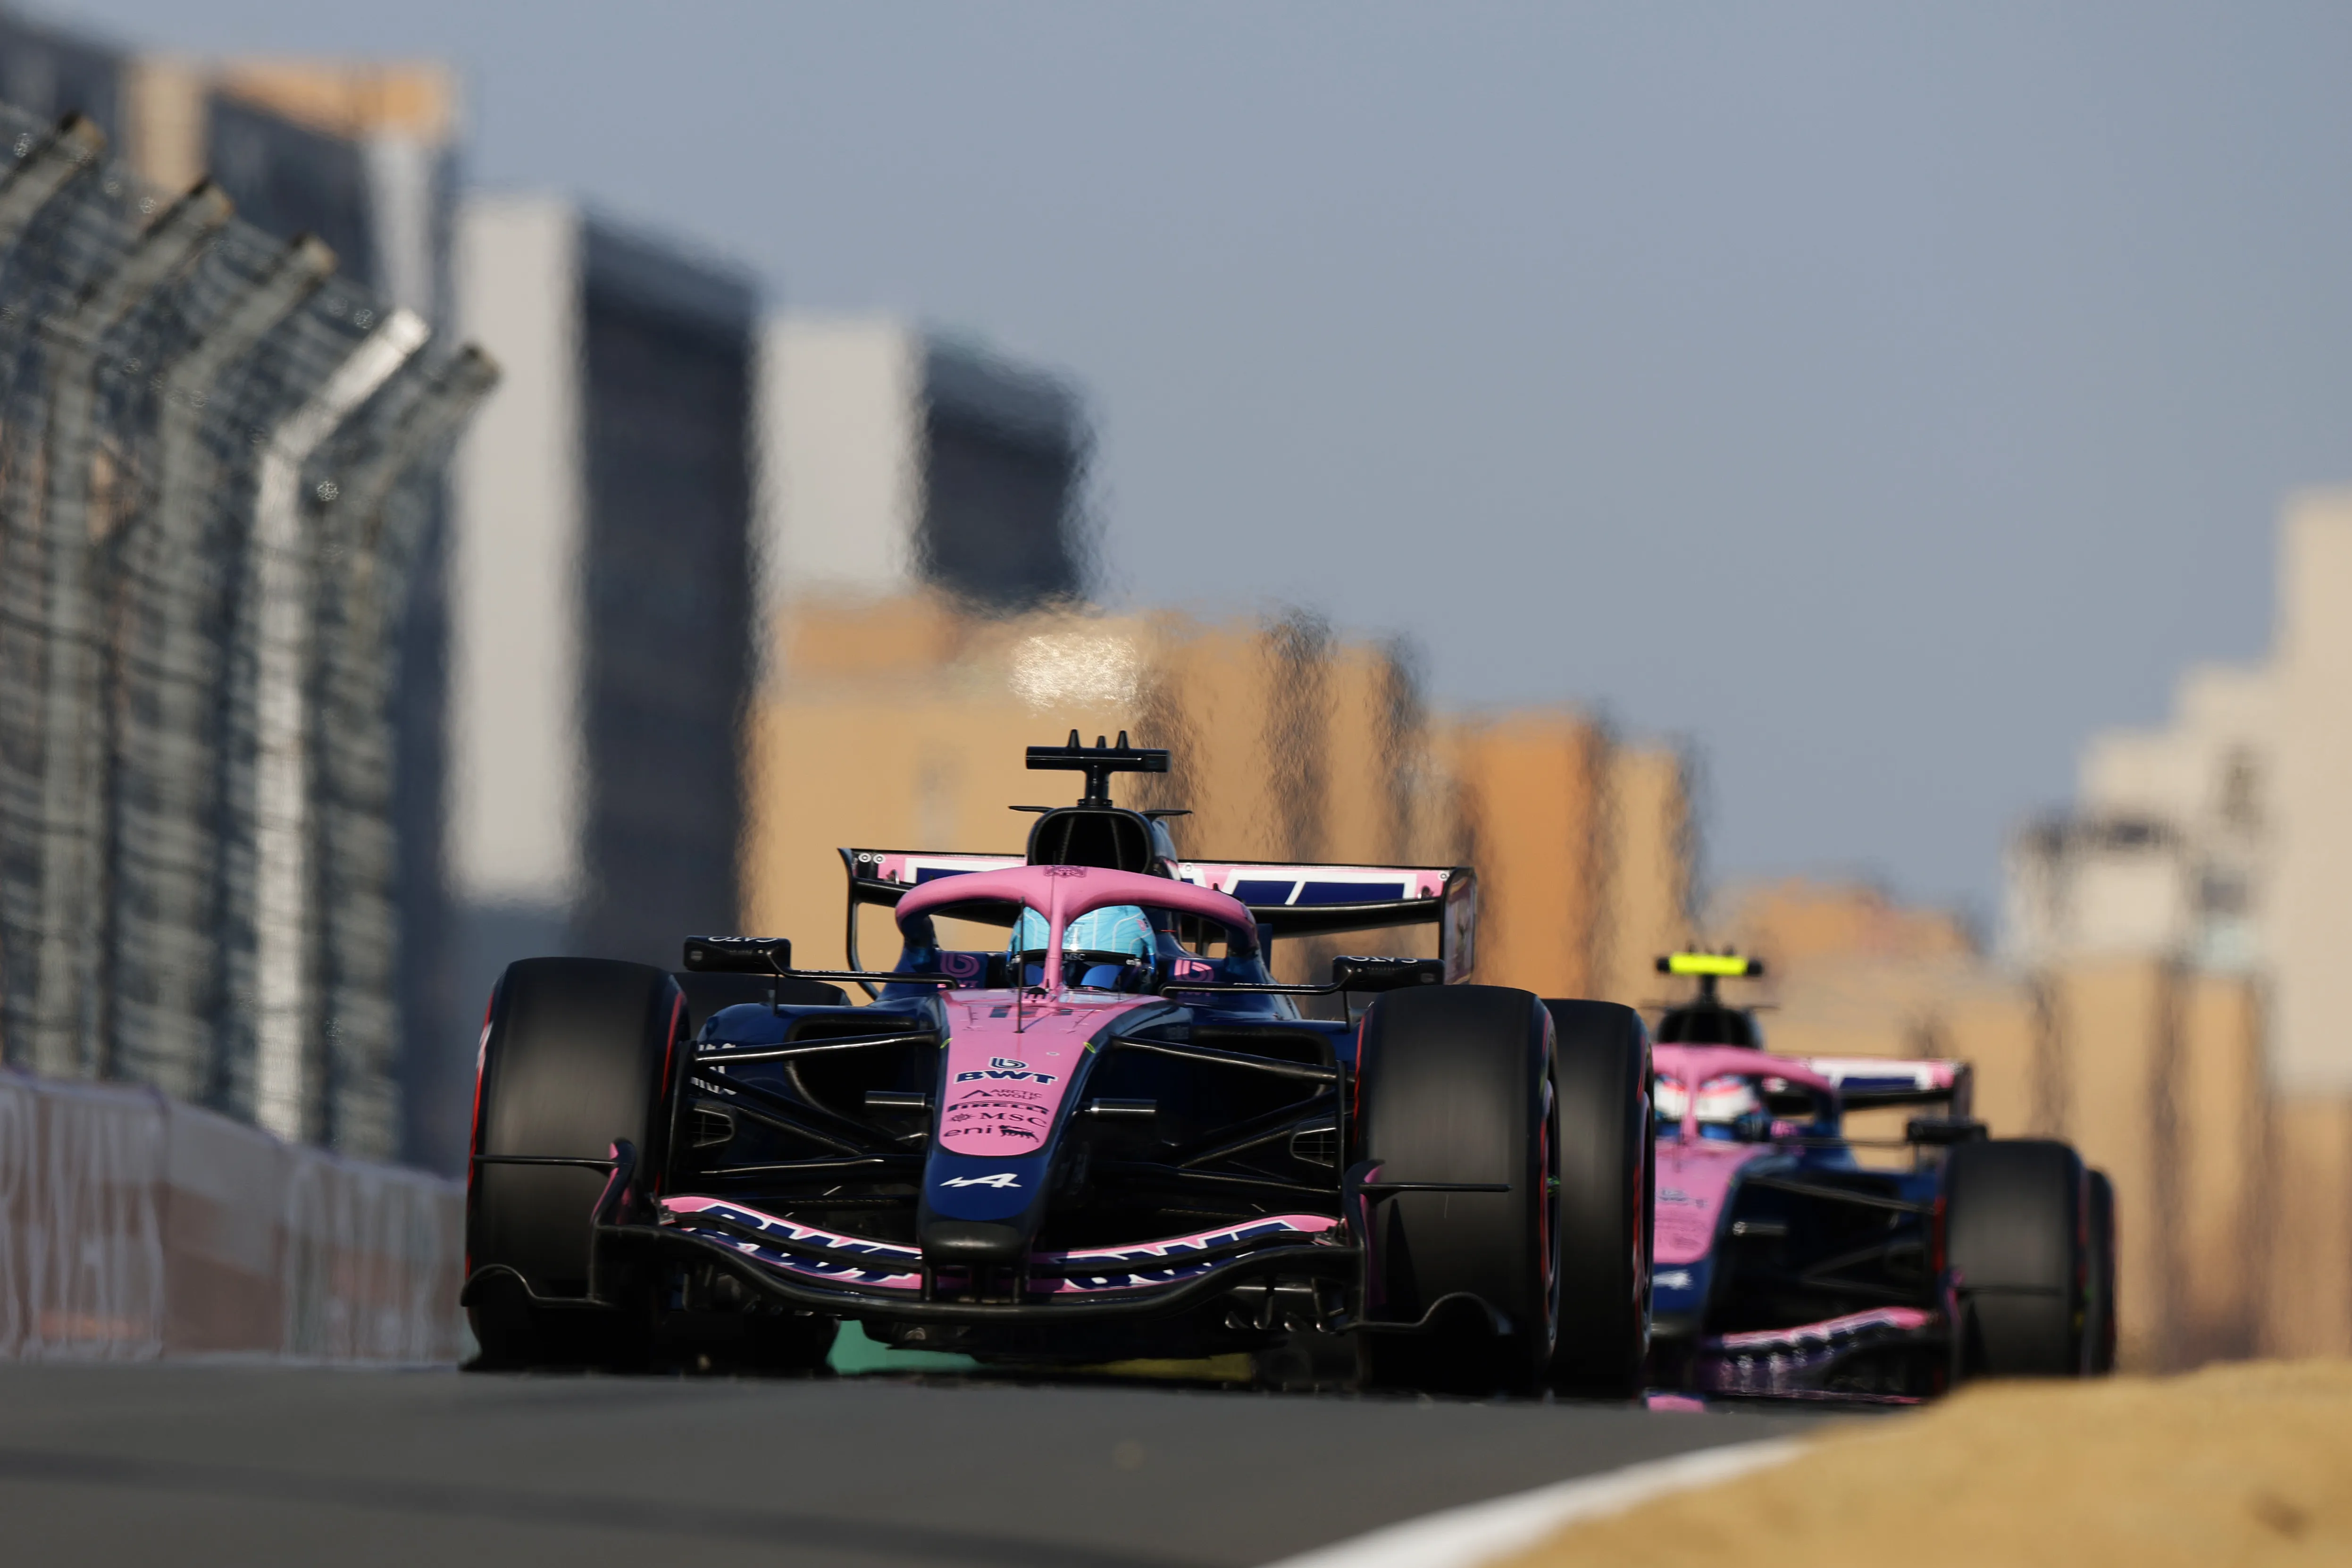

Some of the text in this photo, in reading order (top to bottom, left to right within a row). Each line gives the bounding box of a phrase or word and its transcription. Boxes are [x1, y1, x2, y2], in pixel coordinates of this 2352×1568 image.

[955, 1071, 1057, 1084] BWT
[990, 1089, 1042, 1098] ARCTIC
[947, 1100, 1050, 1115] PIRELLI
[978, 1112, 1047, 1128] MSC
[943, 1125, 993, 1137] eni
